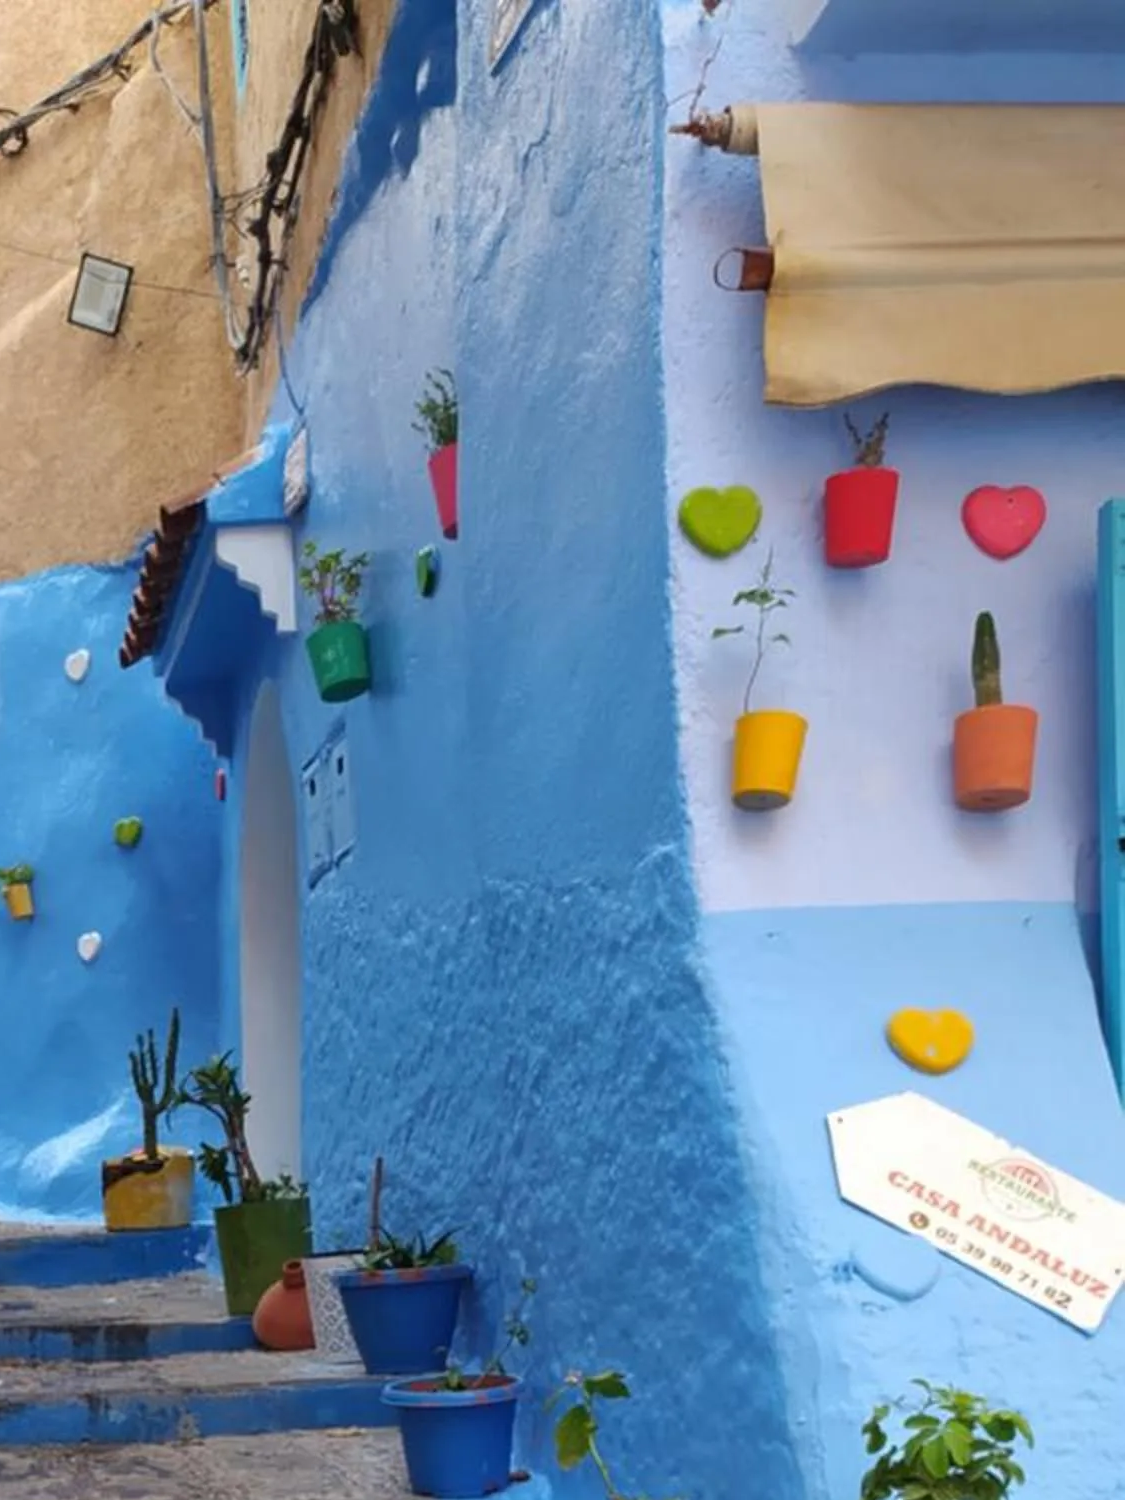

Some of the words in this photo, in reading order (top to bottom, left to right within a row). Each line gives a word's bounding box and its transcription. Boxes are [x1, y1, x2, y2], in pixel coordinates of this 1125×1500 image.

[887, 1170, 961, 1219] CASA
[966, 1213, 1111, 1300] ANDALUZ
[935, 1226, 958, 1246] 05
[961, 1242, 986, 1261] 39
[1018, 1270, 1039, 1289] 71
